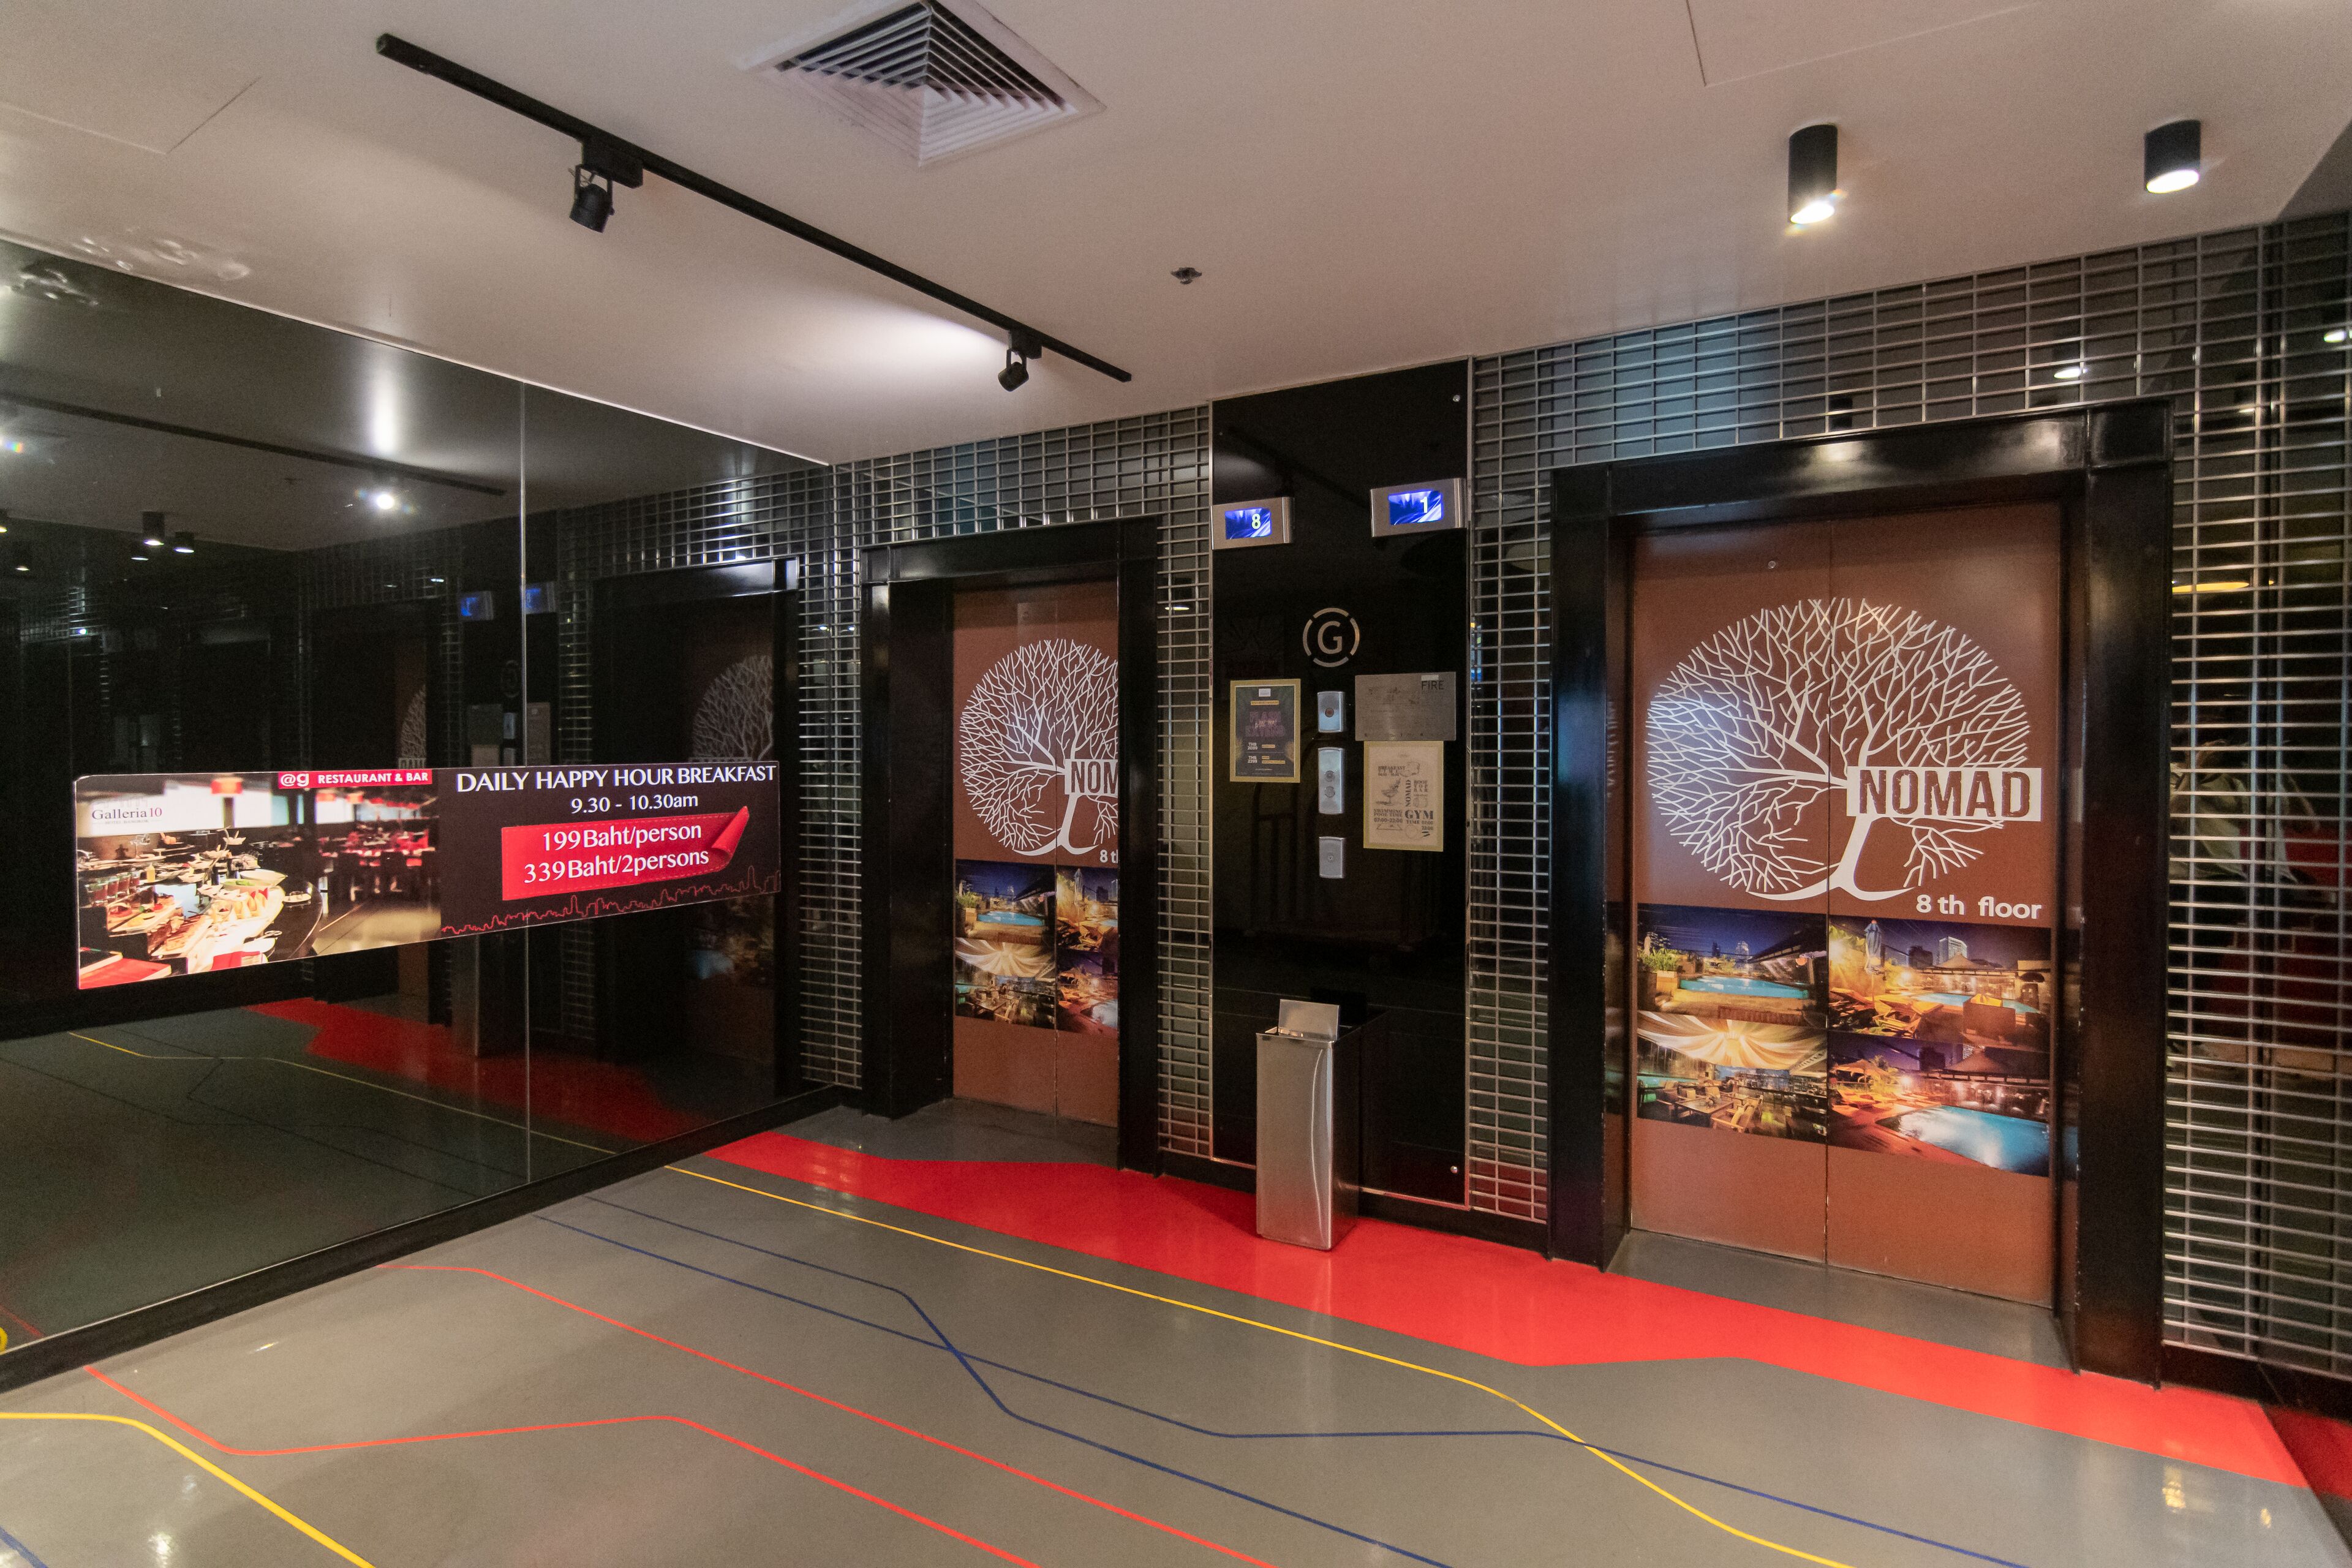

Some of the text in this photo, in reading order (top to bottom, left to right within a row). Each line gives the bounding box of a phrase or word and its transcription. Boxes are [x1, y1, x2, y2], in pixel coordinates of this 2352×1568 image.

[1420, 496, 1429, 513] 1
[1251, 513, 1261, 530] 8
[1317, 620, 1343, 655] G
[1421, 680, 1445, 690] FIRE
[317, 773, 393, 784] RESTAURANT
[395, 773, 404, 782] &
[406, 772, 429, 782] BAR
[456, 766, 777, 793] DAILY HAPPY HOUR BREAKFAST
[1860, 769, 2030, 818] NOMAD
[571, 796, 611, 814] 9.30
[628, 794, 698, 810] 10.30am
[1404, 810, 1434, 820] GYM
[1099, 850, 1118, 863] 8 t
[1916, 895, 2042, 920] 8 th floor
